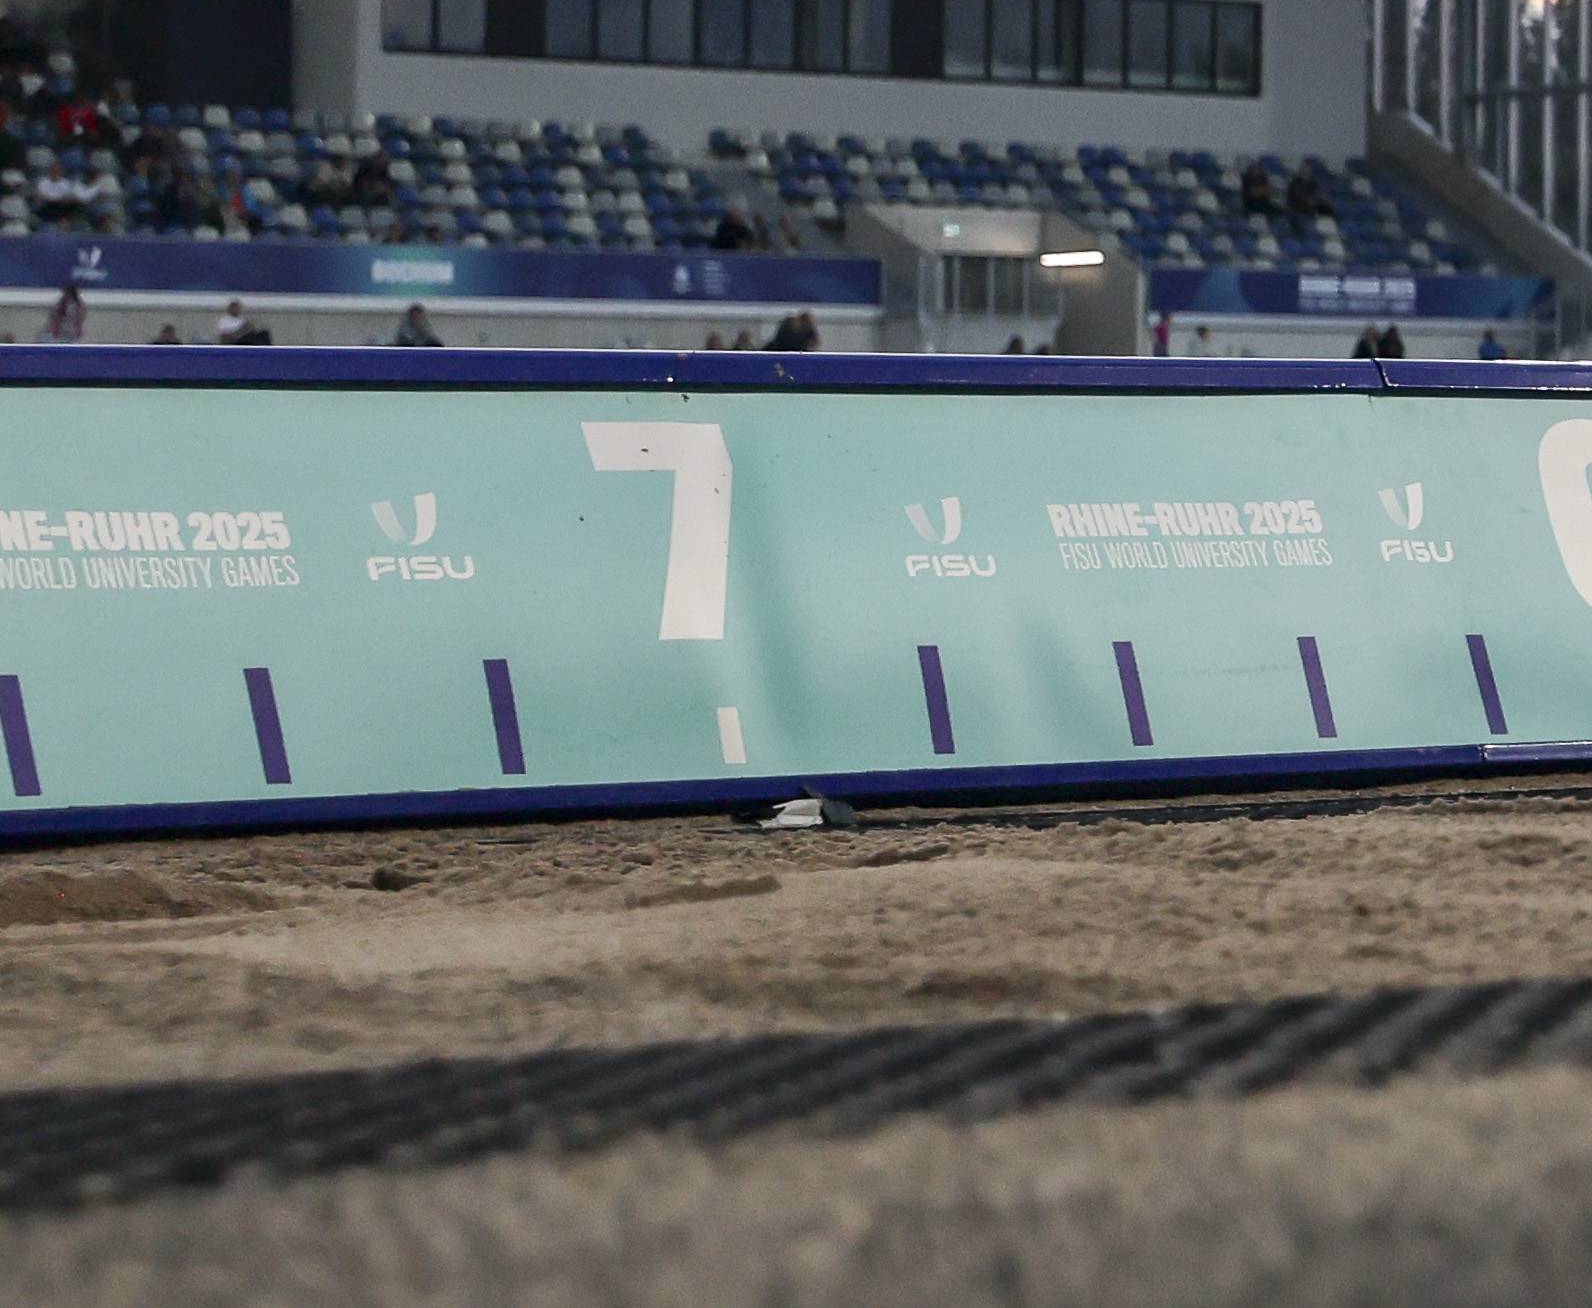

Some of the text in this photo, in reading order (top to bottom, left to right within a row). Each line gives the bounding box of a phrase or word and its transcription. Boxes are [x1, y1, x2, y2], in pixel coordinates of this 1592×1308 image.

[187, 511, 291, 551] 2025
[581, 421, 733, 641] 7
[1046, 500, 1323, 537] RHINE-RUHR 2025
[905, 555, 996, 577] FISU
[1059, 538, 1334, 570] FISU WORLD UNIVERSITY GAMES
[1380, 539, 1453, 562] FISU
[82, 556, 212, 590] UNIVERSITY
[221, 555, 300, 587] GAMES
[367, 555, 475, 581] FISU
